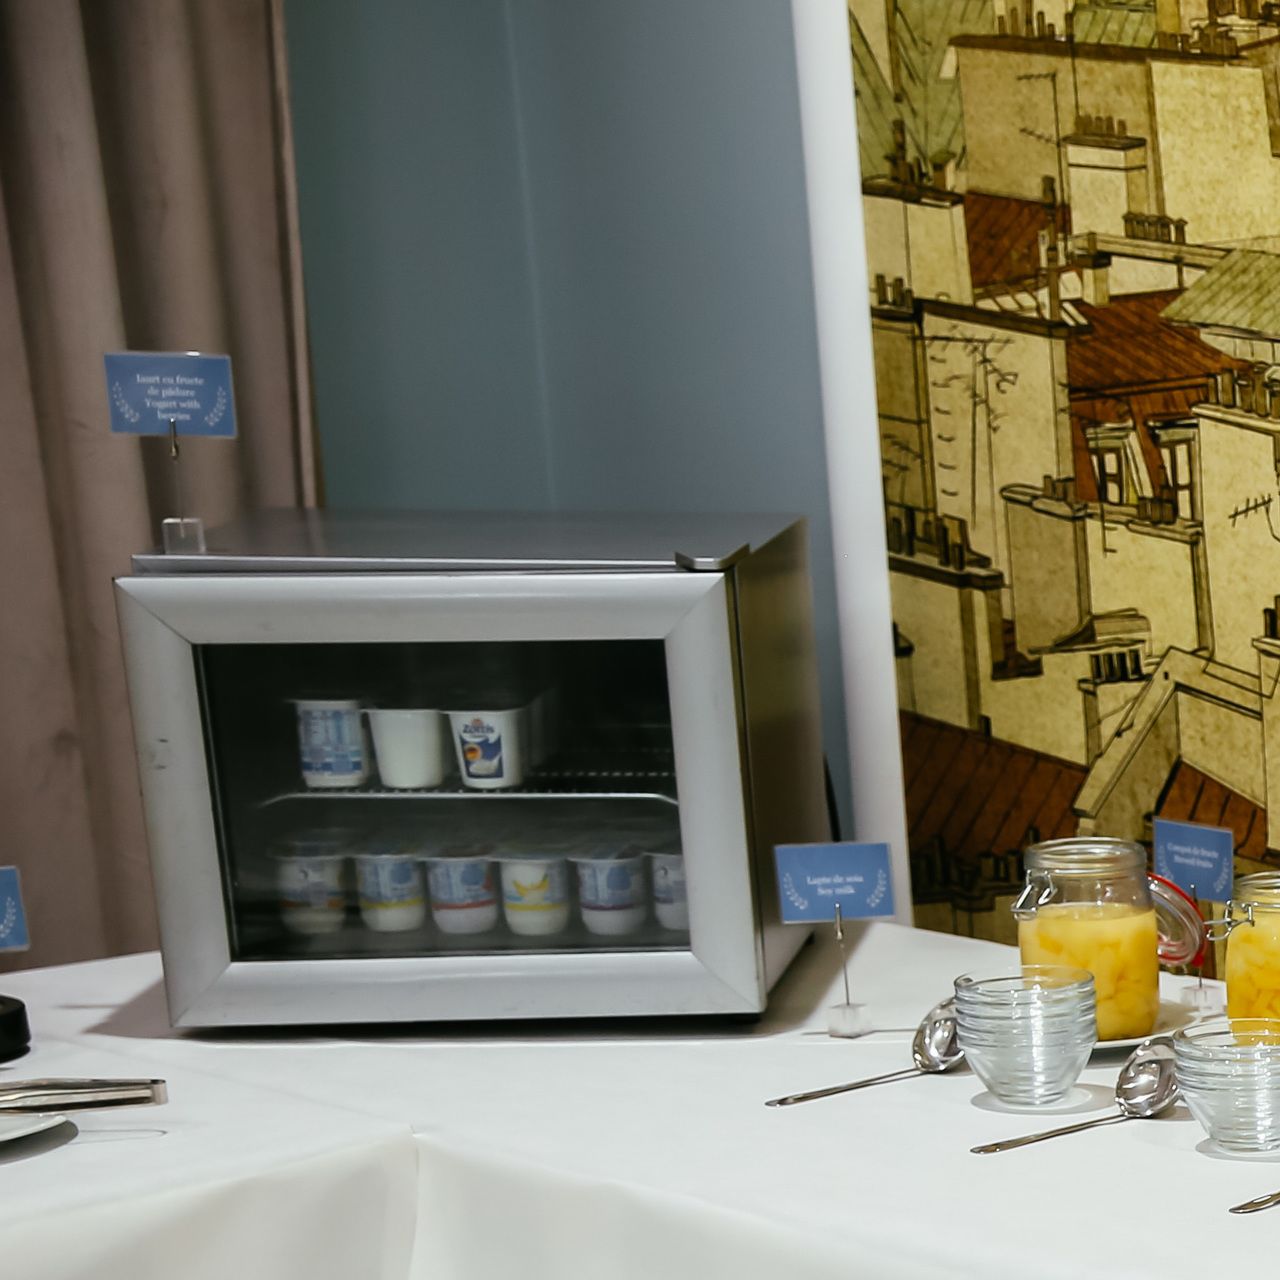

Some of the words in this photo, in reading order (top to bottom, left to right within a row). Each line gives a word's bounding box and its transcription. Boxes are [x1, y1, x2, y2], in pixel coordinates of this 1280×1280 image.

[176, 374, 204, 385] fructe
[147, 386, 159, 395] de
[144, 398, 177, 410] Yogurt
[178, 400, 200, 409] with
